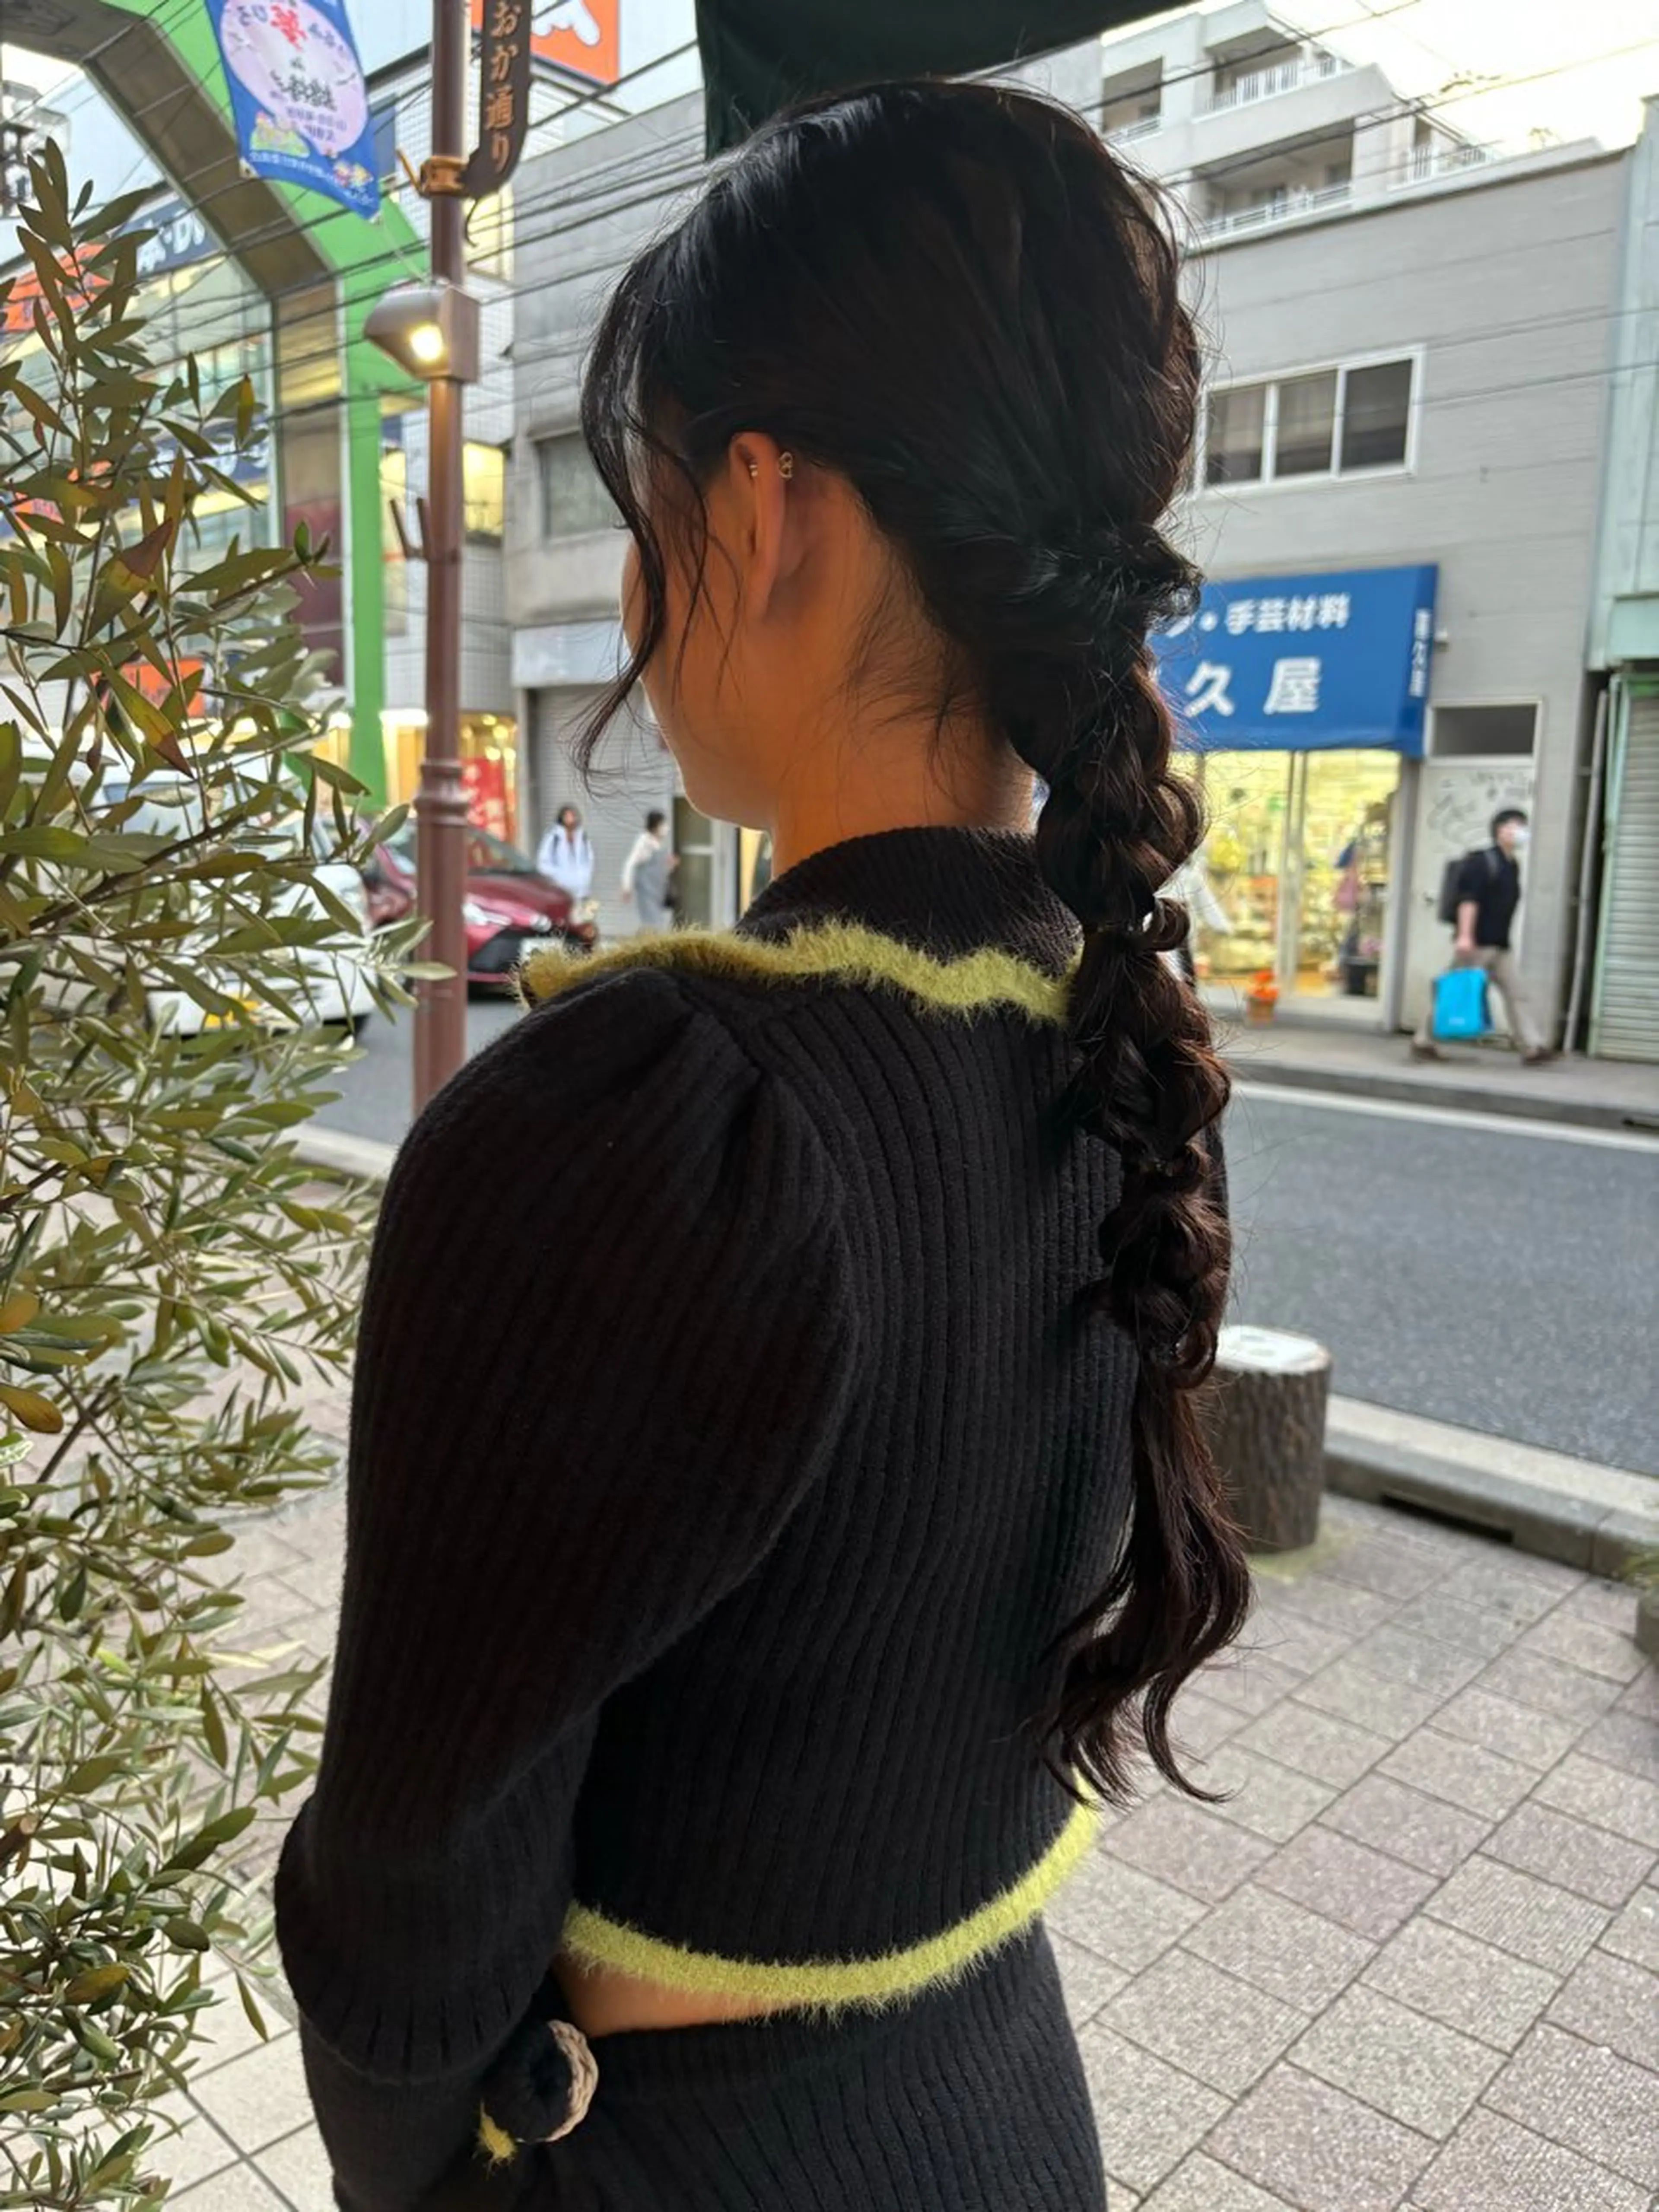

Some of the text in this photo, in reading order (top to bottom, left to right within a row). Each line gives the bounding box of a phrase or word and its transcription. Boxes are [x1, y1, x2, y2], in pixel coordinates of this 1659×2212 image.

[1166, 592, 1351, 637] ・手芸材料
